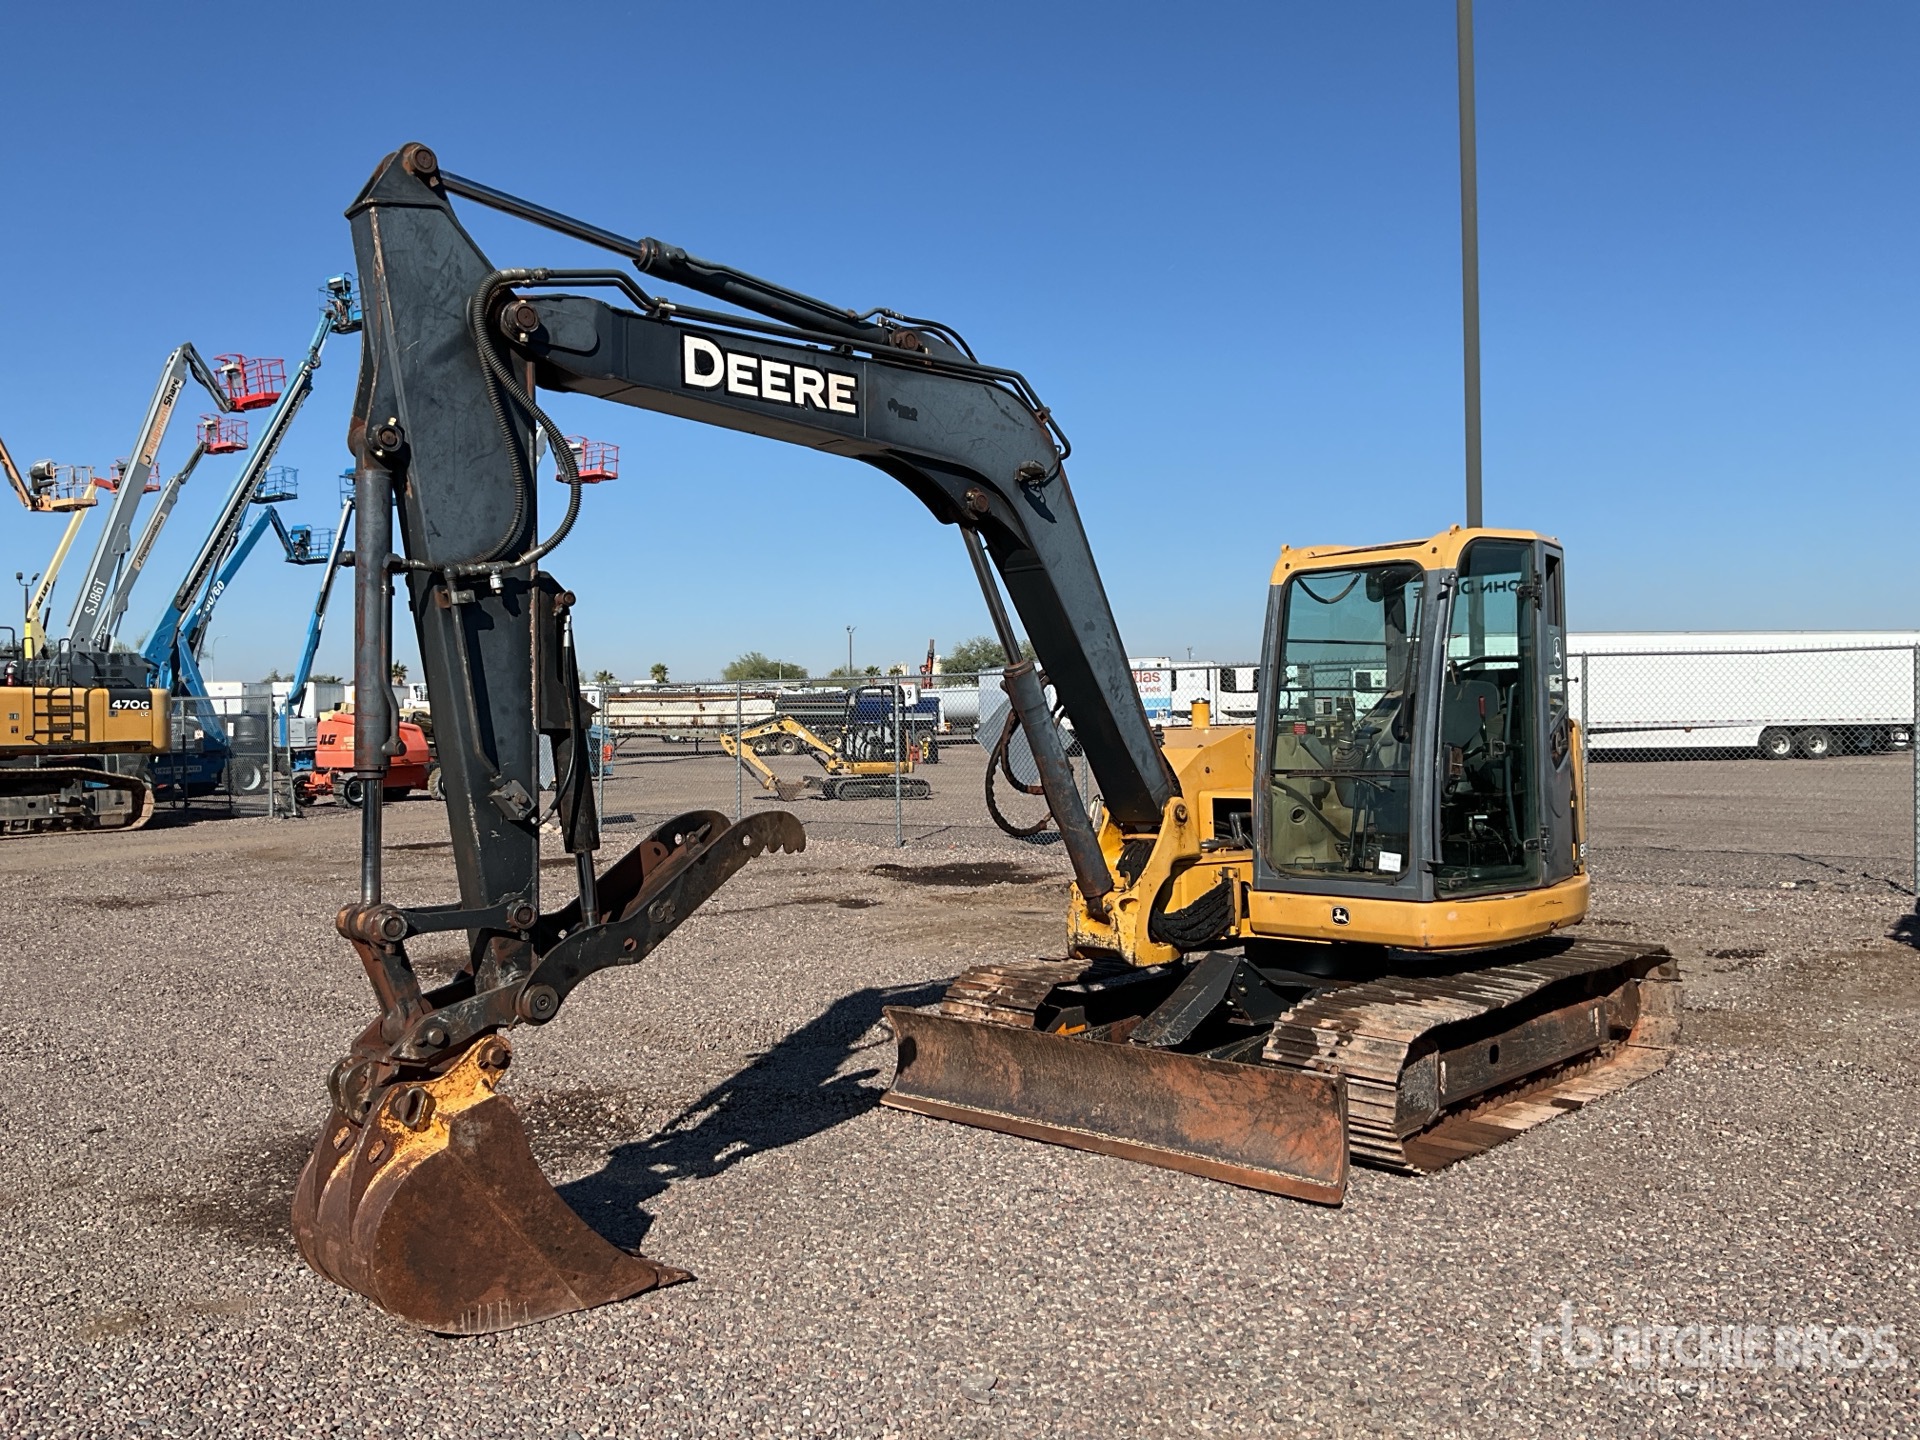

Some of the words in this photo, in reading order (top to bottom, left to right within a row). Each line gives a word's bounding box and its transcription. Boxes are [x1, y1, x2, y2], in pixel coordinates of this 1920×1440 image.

[684, 334, 857, 414] DEERE
[145, 378, 181, 455] EquipmentShare
[138, 515, 165, 562] EquipmentShare
[84, 577, 107, 616] SJ86T
[1131, 670, 1161, 683] tlas
[591, 695, 596, 703] 8
[906, 689, 912, 699] 9
[111, 699, 150, 710] 470G
[319, 733, 338, 746] JLG
